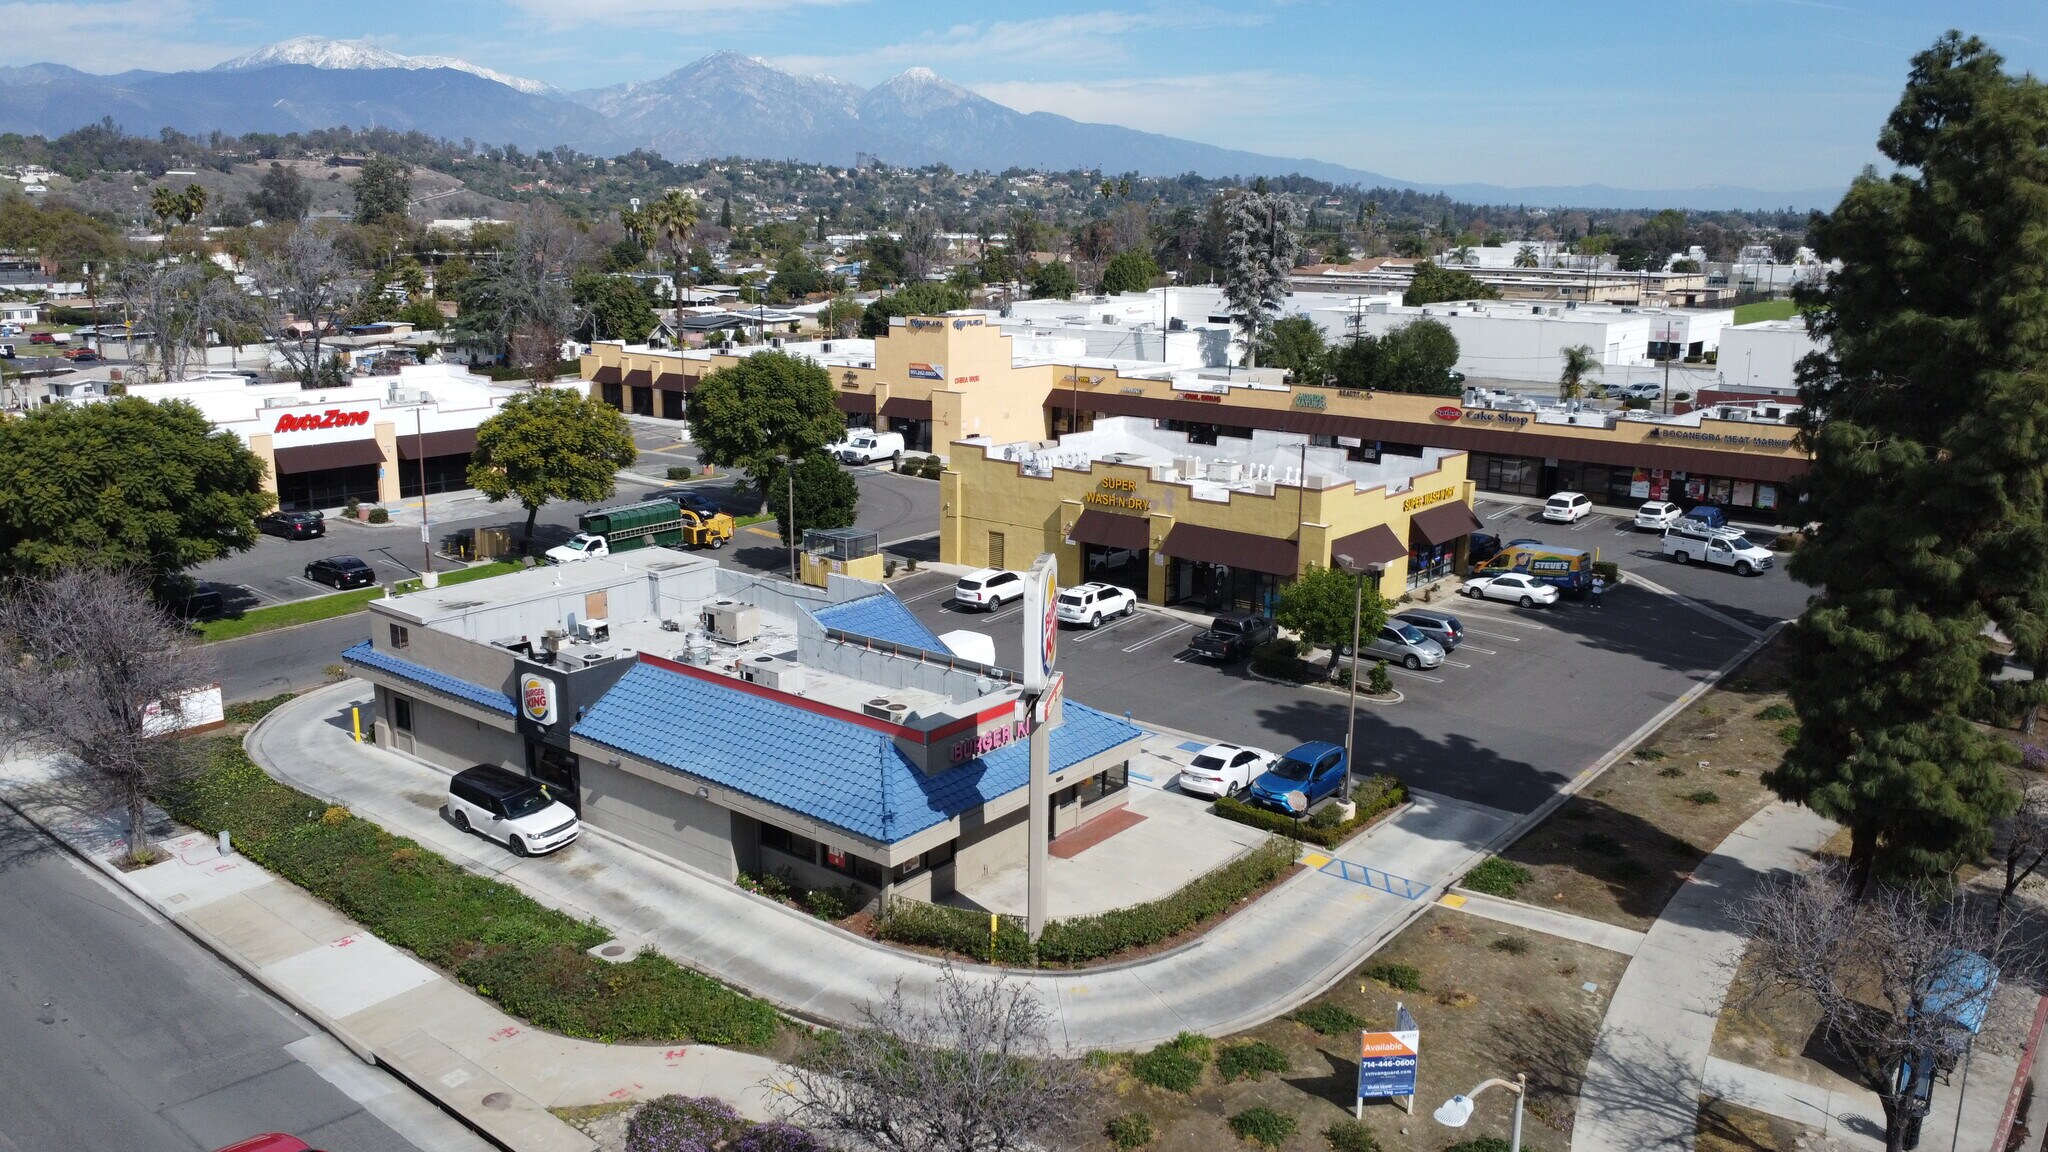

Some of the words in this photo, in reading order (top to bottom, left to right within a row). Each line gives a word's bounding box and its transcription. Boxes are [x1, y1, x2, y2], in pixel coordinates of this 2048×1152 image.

[1339, 389, 1359, 398] BEAUTY
[274, 409, 370, 433] AutoZone
[1465, 410, 1494, 420] Cake
[1497, 411, 1528, 426] Shop
[1662, 429, 1721, 443] BOCANEGRA
[1724, 434, 1750, 445] MEAT
[1753, 437, 1792, 448] MARKET
[1102, 477, 1136, 492] SUPER
[1086, 491, 1116, 506] WASH
[1128, 497, 1150, 511] DRY
[1403, 497, 1423, 511] SUPER
[1533, 561, 1569, 570] STEVE'S
[525, 688, 545, 699] BURGER
[527, 696, 547, 709] KING
[953, 724, 1011, 763] BURGER
[1017, 717, 1031, 738] KI
[1364, 1043, 1403, 1052] Available
[1363, 1059, 1415, 1068] 714-446-0600
